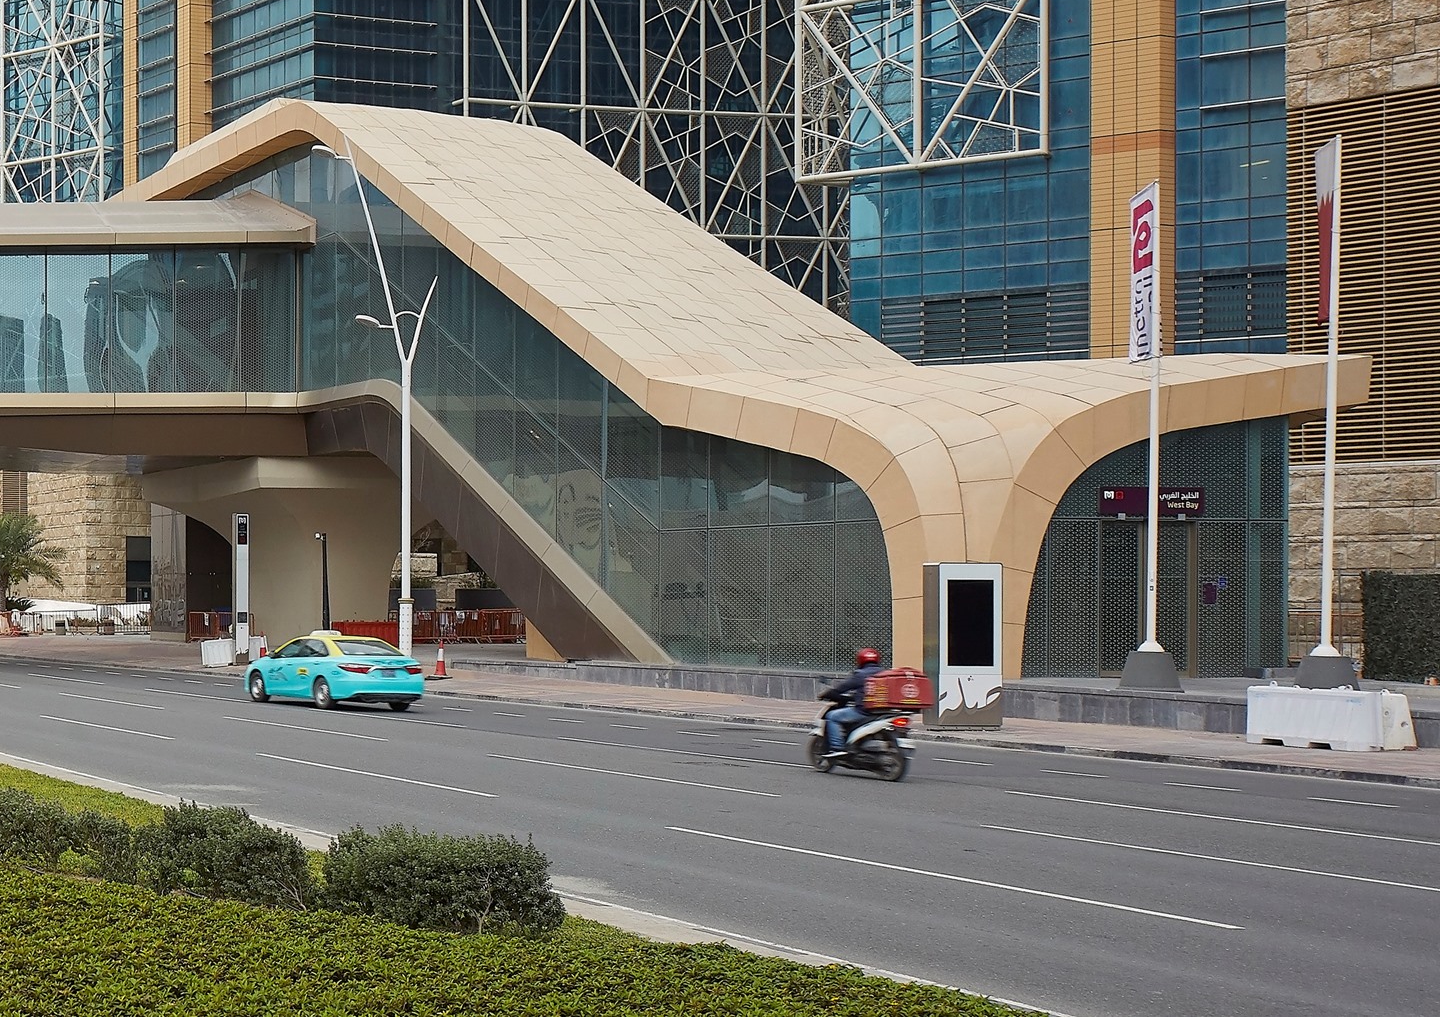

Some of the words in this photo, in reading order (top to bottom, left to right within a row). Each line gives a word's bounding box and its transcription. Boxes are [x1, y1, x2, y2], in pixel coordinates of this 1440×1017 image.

[1159, 491, 1180, 501] الغربي
[1181, 491, 1199, 500] الخليج
[1167, 501, 1184, 509] West
[1185, 501, 1199, 510] Bay
